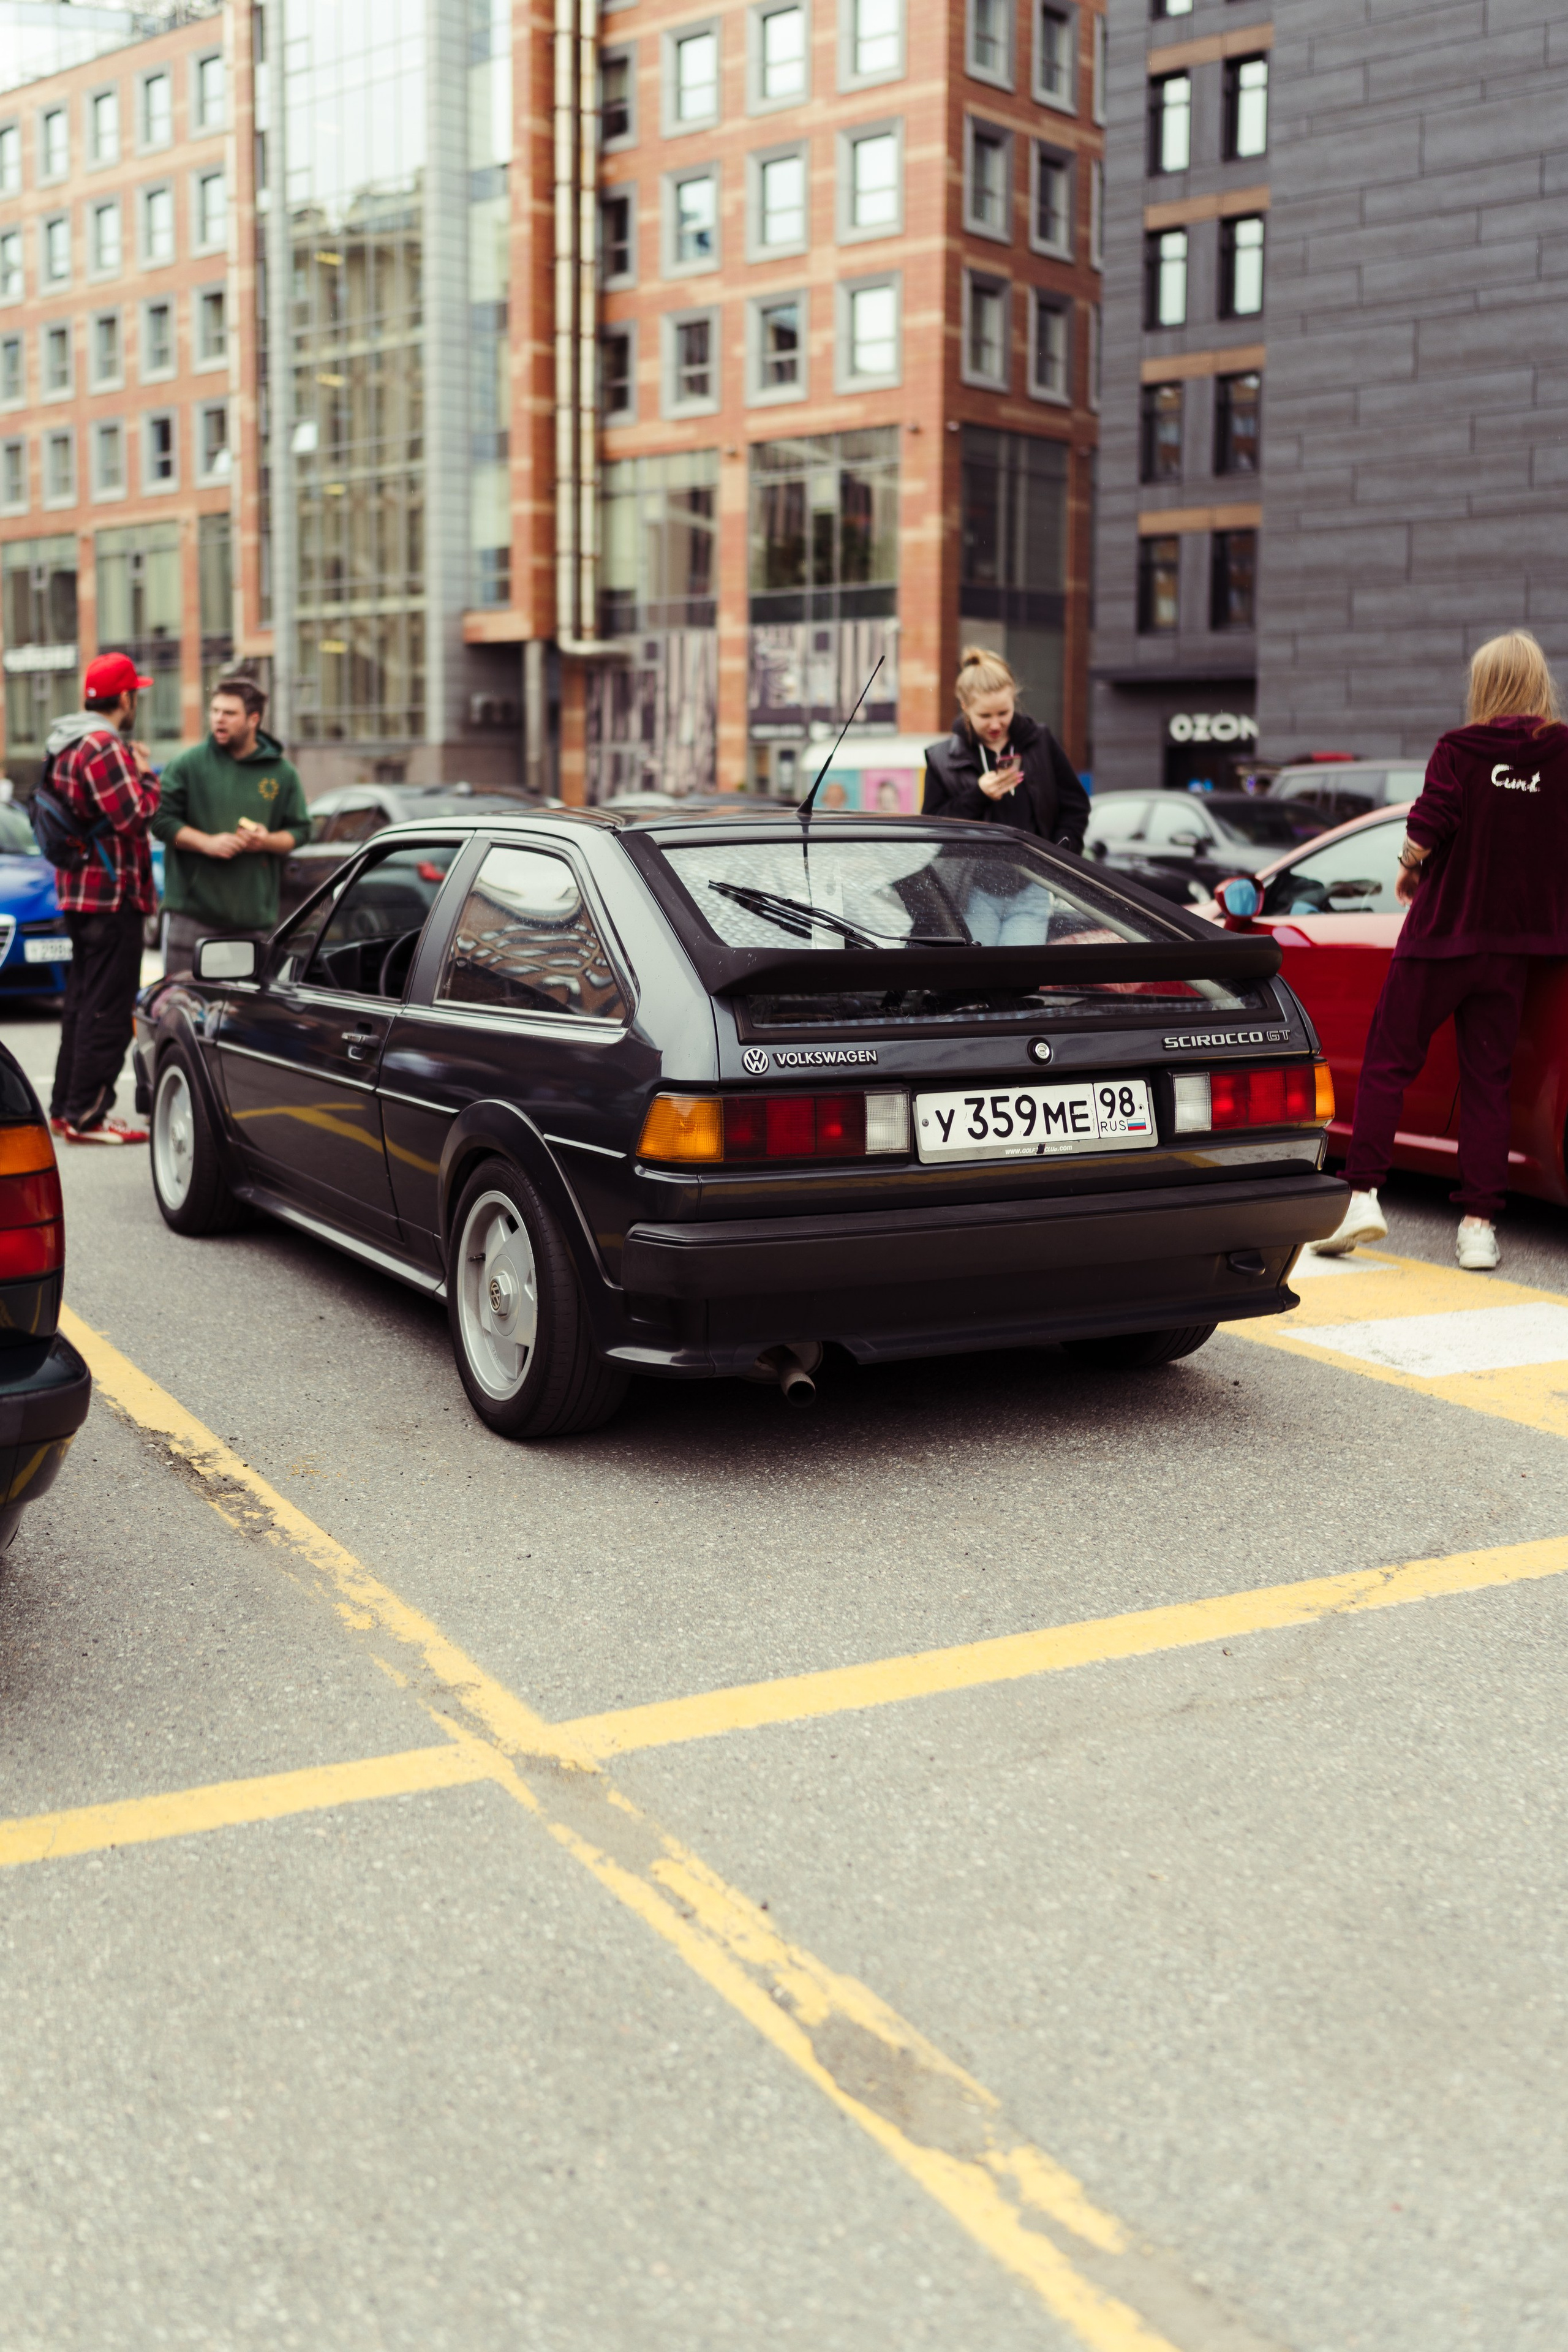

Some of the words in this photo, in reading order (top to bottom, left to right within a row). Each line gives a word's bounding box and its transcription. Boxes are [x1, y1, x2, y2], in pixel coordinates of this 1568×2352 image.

[1169, 712, 1259, 742] OZON
[1164, 1031, 1263, 1048] SCIROCCO
[1265, 1029, 1291, 1041] GT
[743, 1048, 768, 1073] VW
[776, 1050, 877, 1065] VOLKSWAGEN
[1099, 1087, 1135, 1118] 98
[1101, 1120, 1126, 1133] RUS
